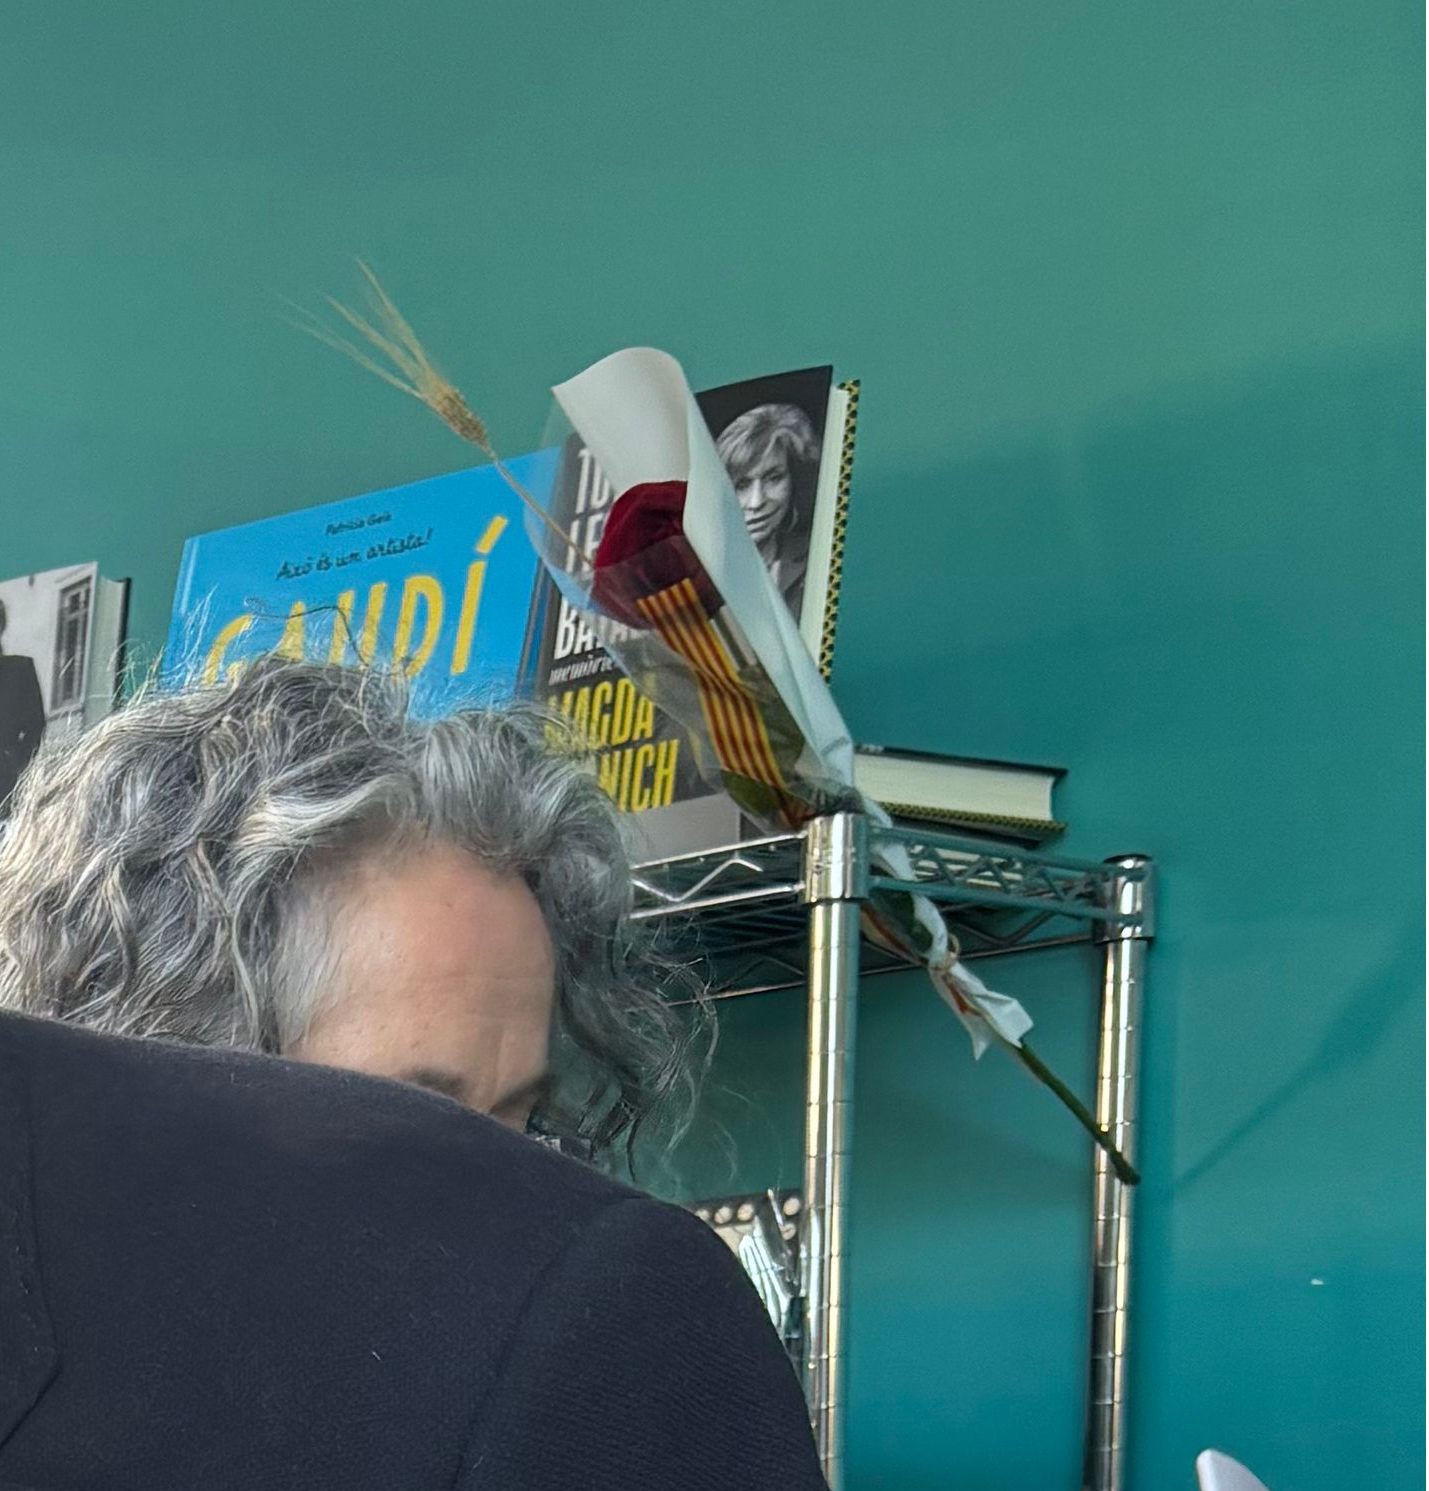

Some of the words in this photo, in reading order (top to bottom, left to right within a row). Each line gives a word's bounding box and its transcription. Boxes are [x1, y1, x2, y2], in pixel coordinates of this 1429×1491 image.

[335, 552, 361, 567] un
[366, 527, 432, 559] artista!
[598, 739, 679, 813] NICH
